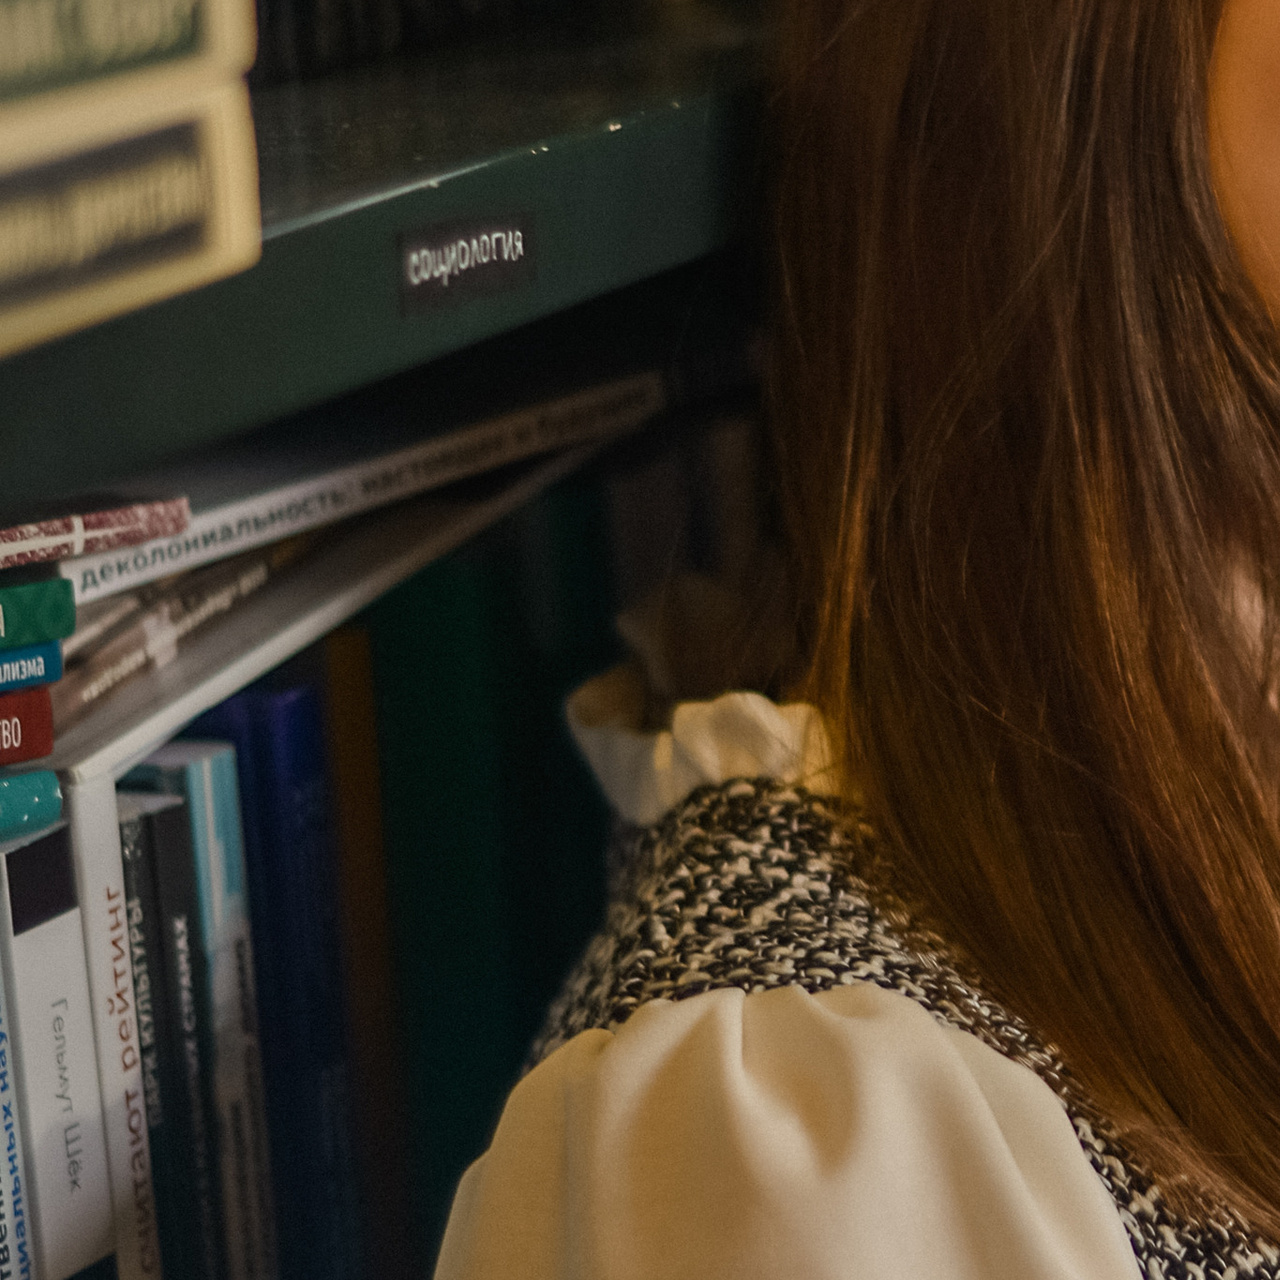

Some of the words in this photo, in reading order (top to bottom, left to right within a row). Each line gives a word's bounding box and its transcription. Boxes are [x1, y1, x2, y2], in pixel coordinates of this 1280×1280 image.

[409, 230, 524, 285] социология
[0, 656, 45, 683] лизма
[0, 717, 21, 749] ВО
[103, 883, 137, 1071] рейтинг
[50, 997, 74, 1115] Гельмут
[63, 1121, 84, 1194] Шёк
[123, 1088, 154, 1274] считают
